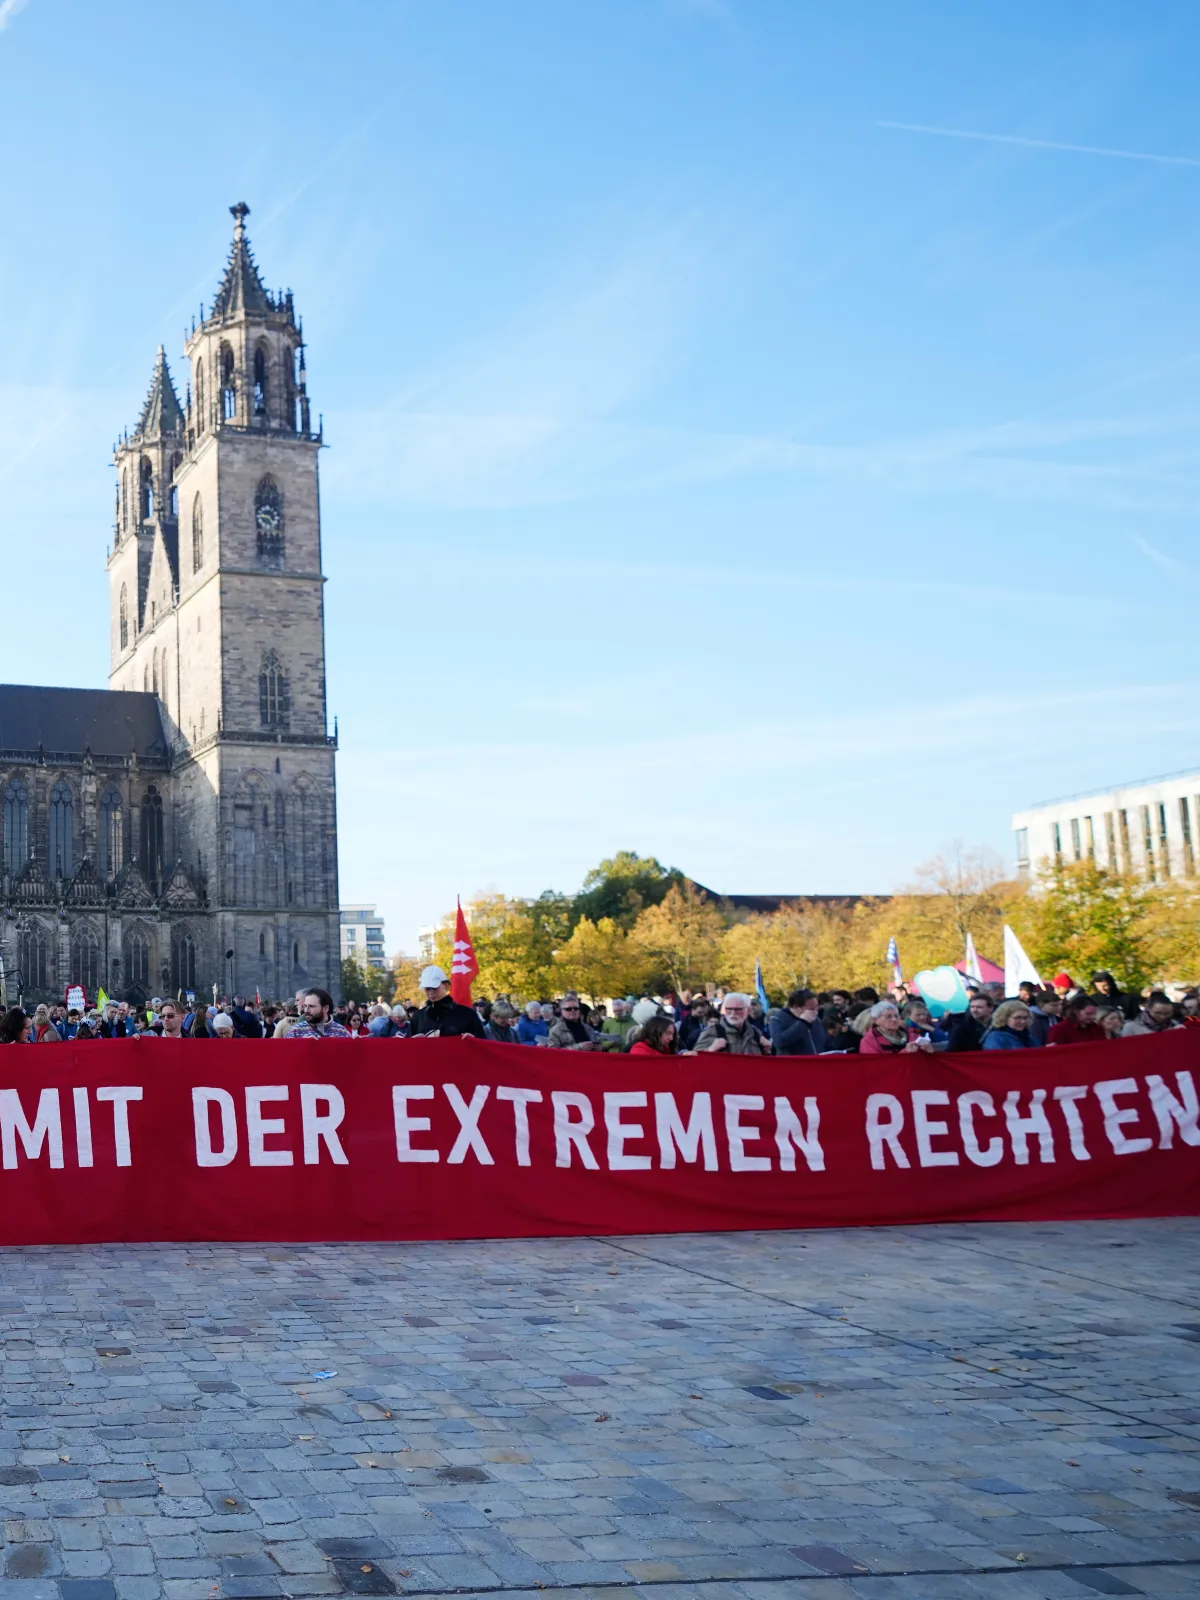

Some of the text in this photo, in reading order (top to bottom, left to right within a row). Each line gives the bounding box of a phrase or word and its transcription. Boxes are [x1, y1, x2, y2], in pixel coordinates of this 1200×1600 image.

[192, 1084, 350, 1168] DER
[393, 1084, 826, 1172] EXTREMEN
[866, 1070, 1200, 1170] RECHTEN
